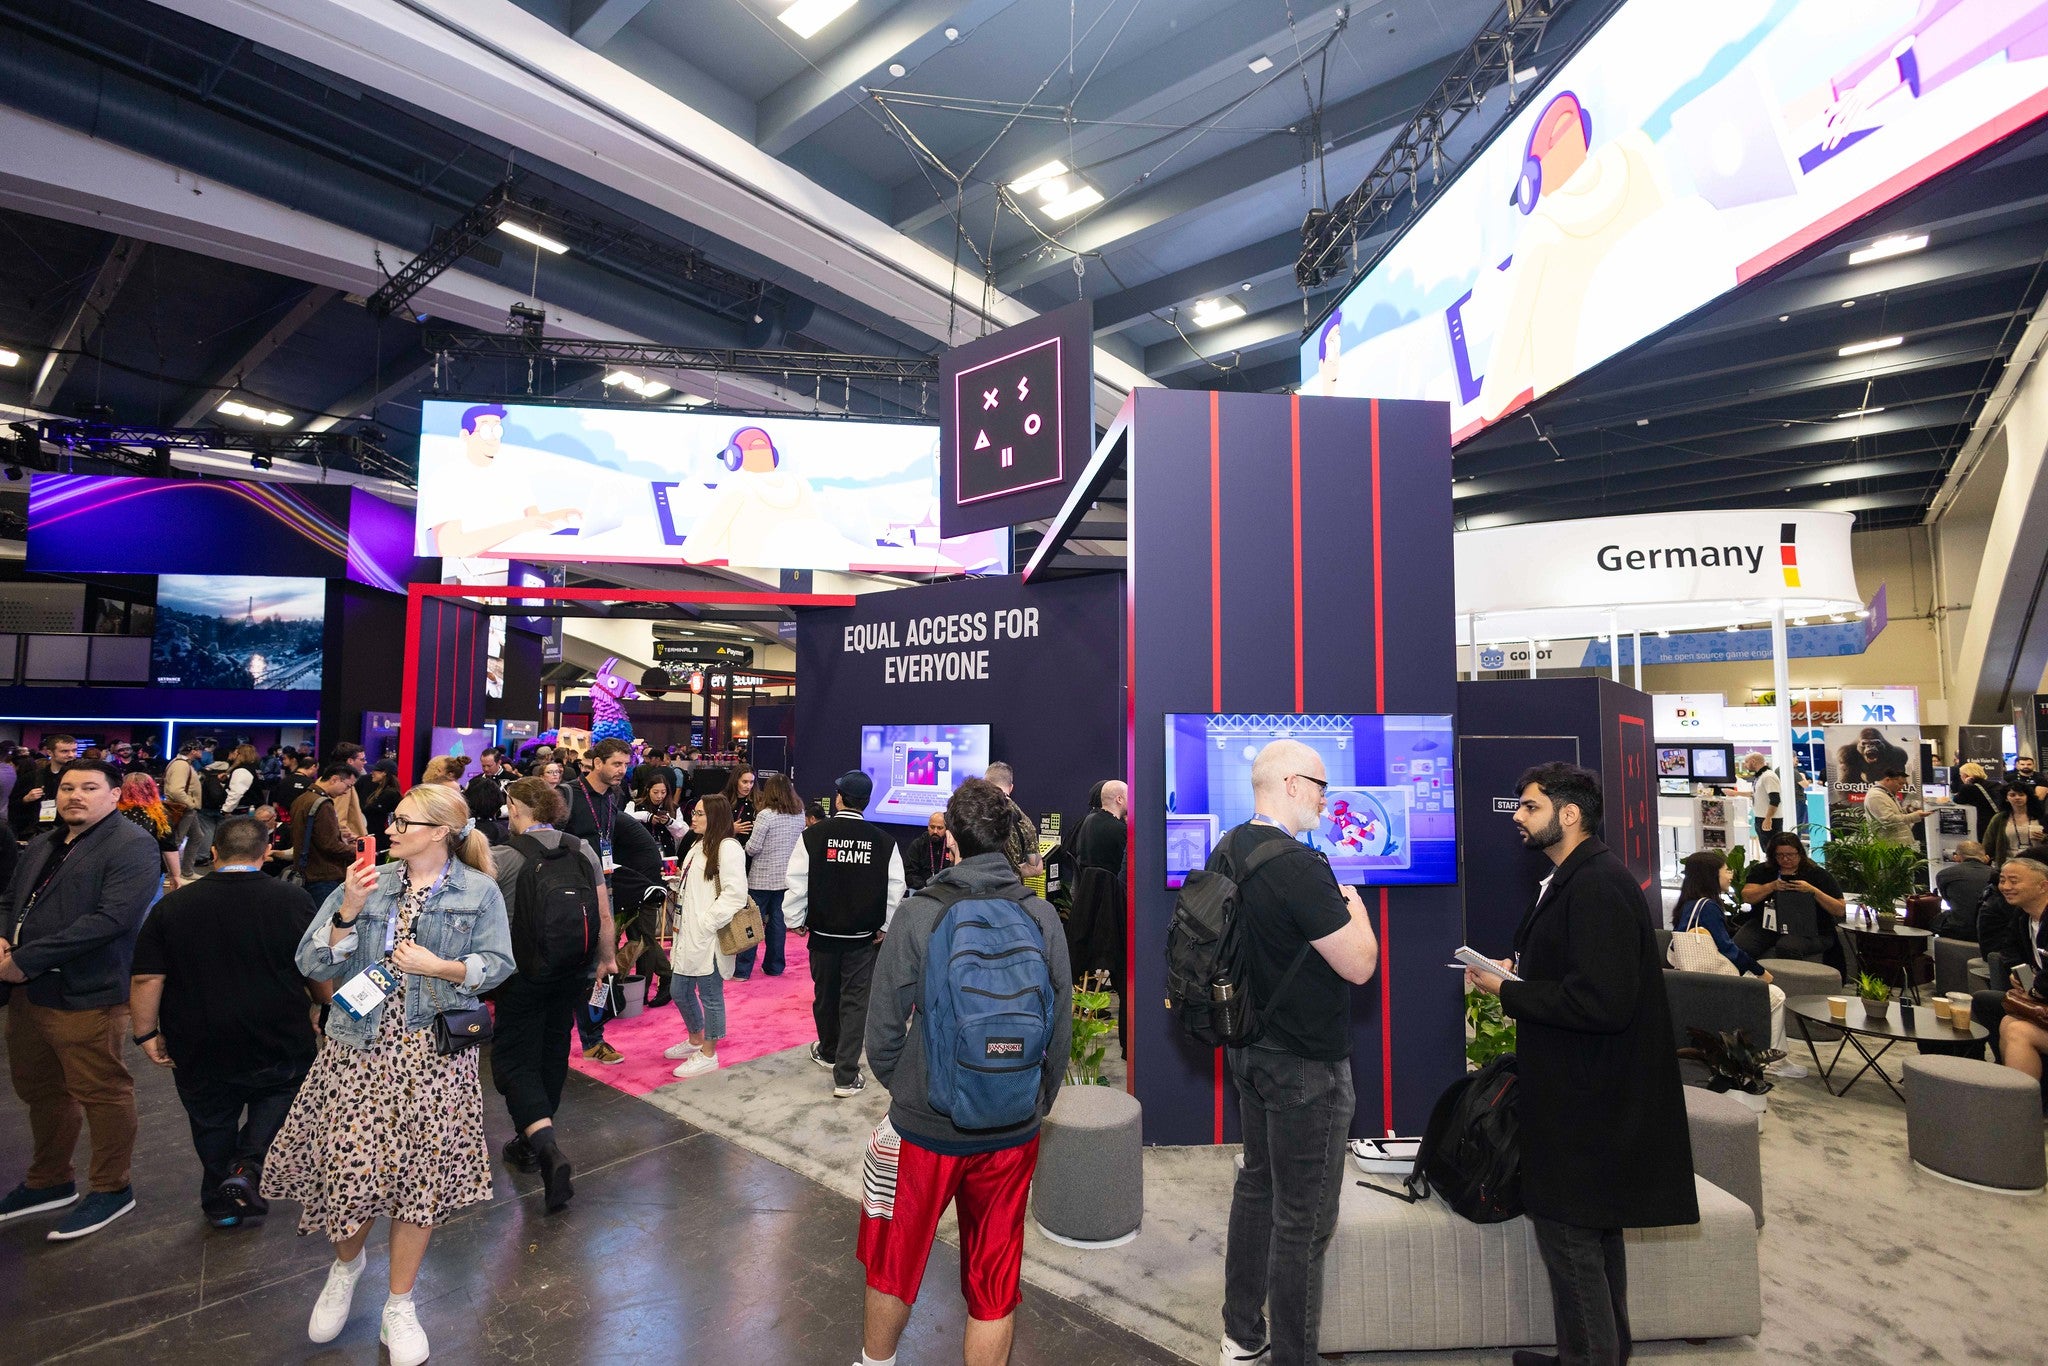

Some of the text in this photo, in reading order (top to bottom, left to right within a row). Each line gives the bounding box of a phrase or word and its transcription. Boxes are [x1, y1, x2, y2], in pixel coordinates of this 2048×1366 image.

[1597, 544, 1763, 574] Germany
[844, 607, 1039, 653] EQUAL ACCESS FOR
[1510, 650, 1552, 661] GOOT
[1674, 653, 1694, 661] open
[1696, 651, 1723, 659] source
[1726, 650, 1749, 659] game
[1751, 648, 1777, 658] engin
[885, 650, 989, 683] EVERYONE
[1497, 800, 1519, 809] STAFF
[827, 839, 872, 850] ENJOY THE
[837, 850, 871, 864] GAME
[368, 969, 391, 991] GDC
[987, 1043, 1022, 1054] JANSPORT
